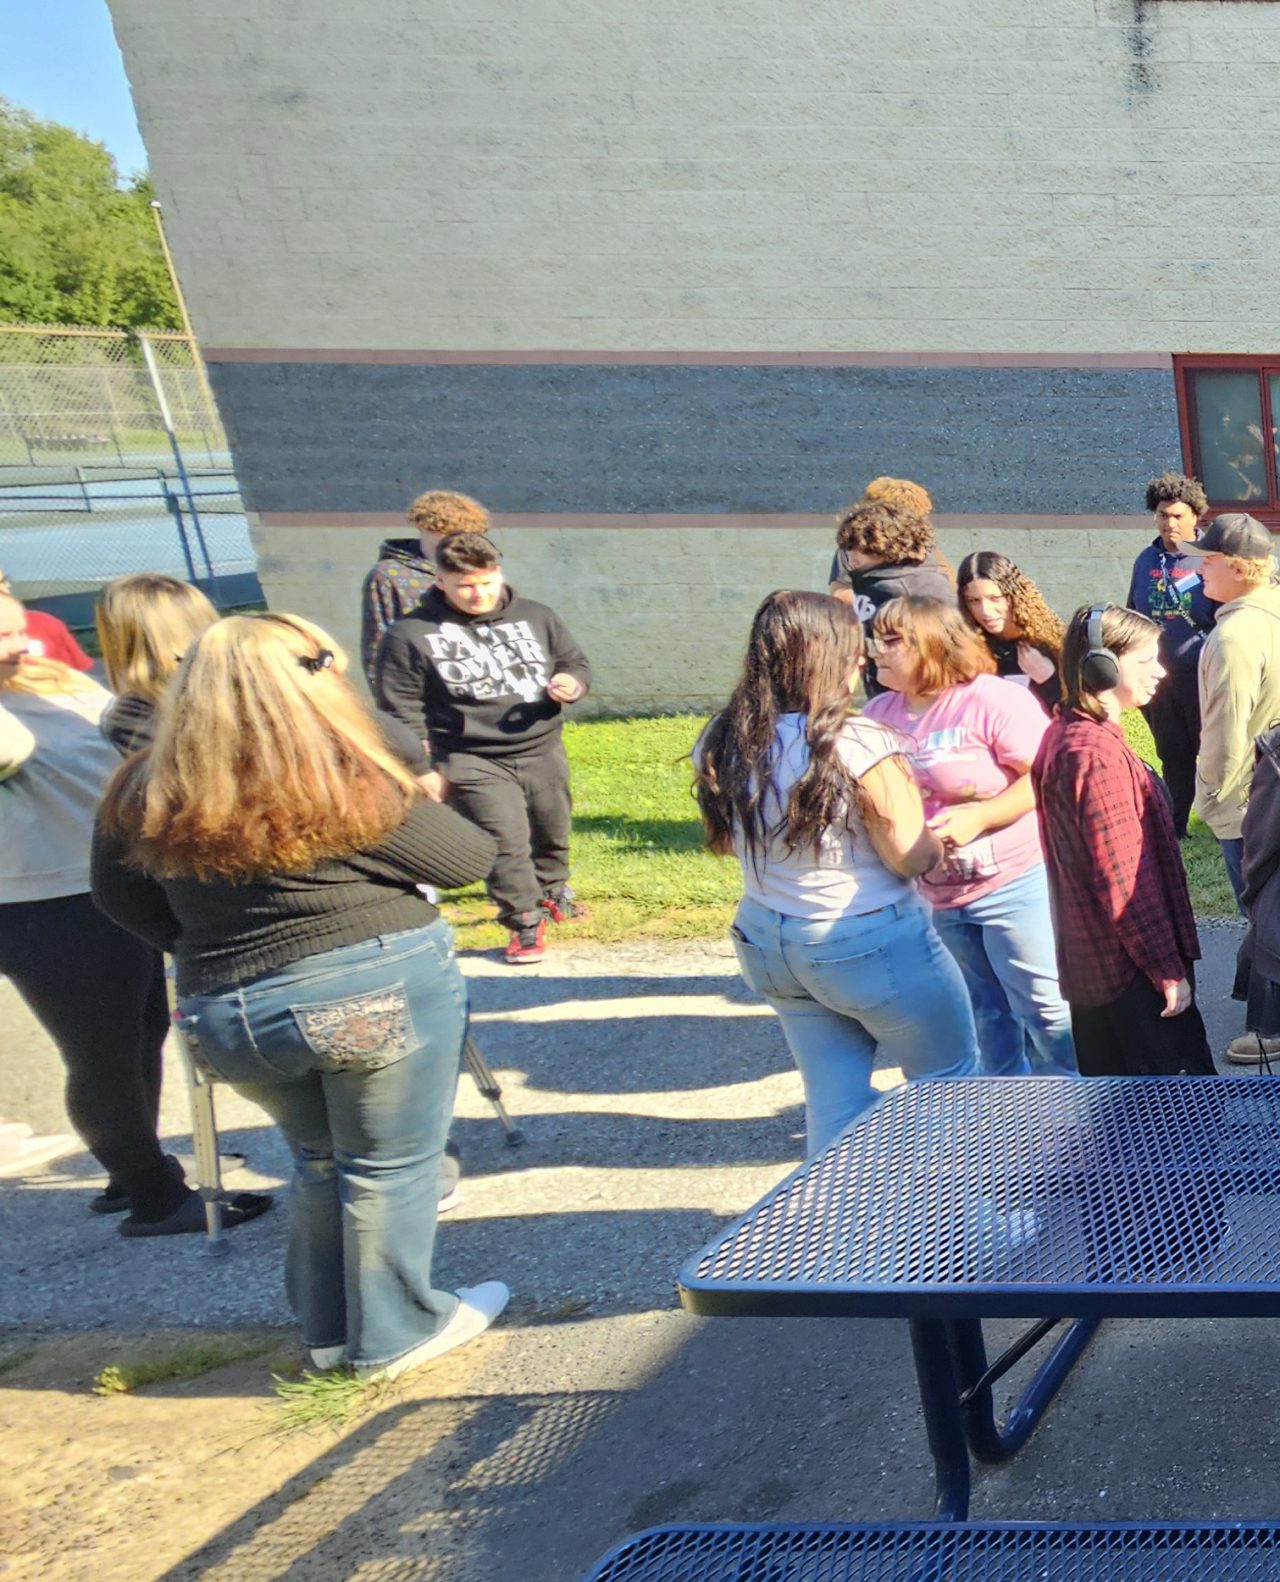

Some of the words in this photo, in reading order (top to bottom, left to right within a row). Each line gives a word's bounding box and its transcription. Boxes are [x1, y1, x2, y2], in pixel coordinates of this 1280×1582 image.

[424, 621, 537, 660] FAITH
[438, 640, 547, 681] OVER
[445, 662, 549, 702] FEAR
